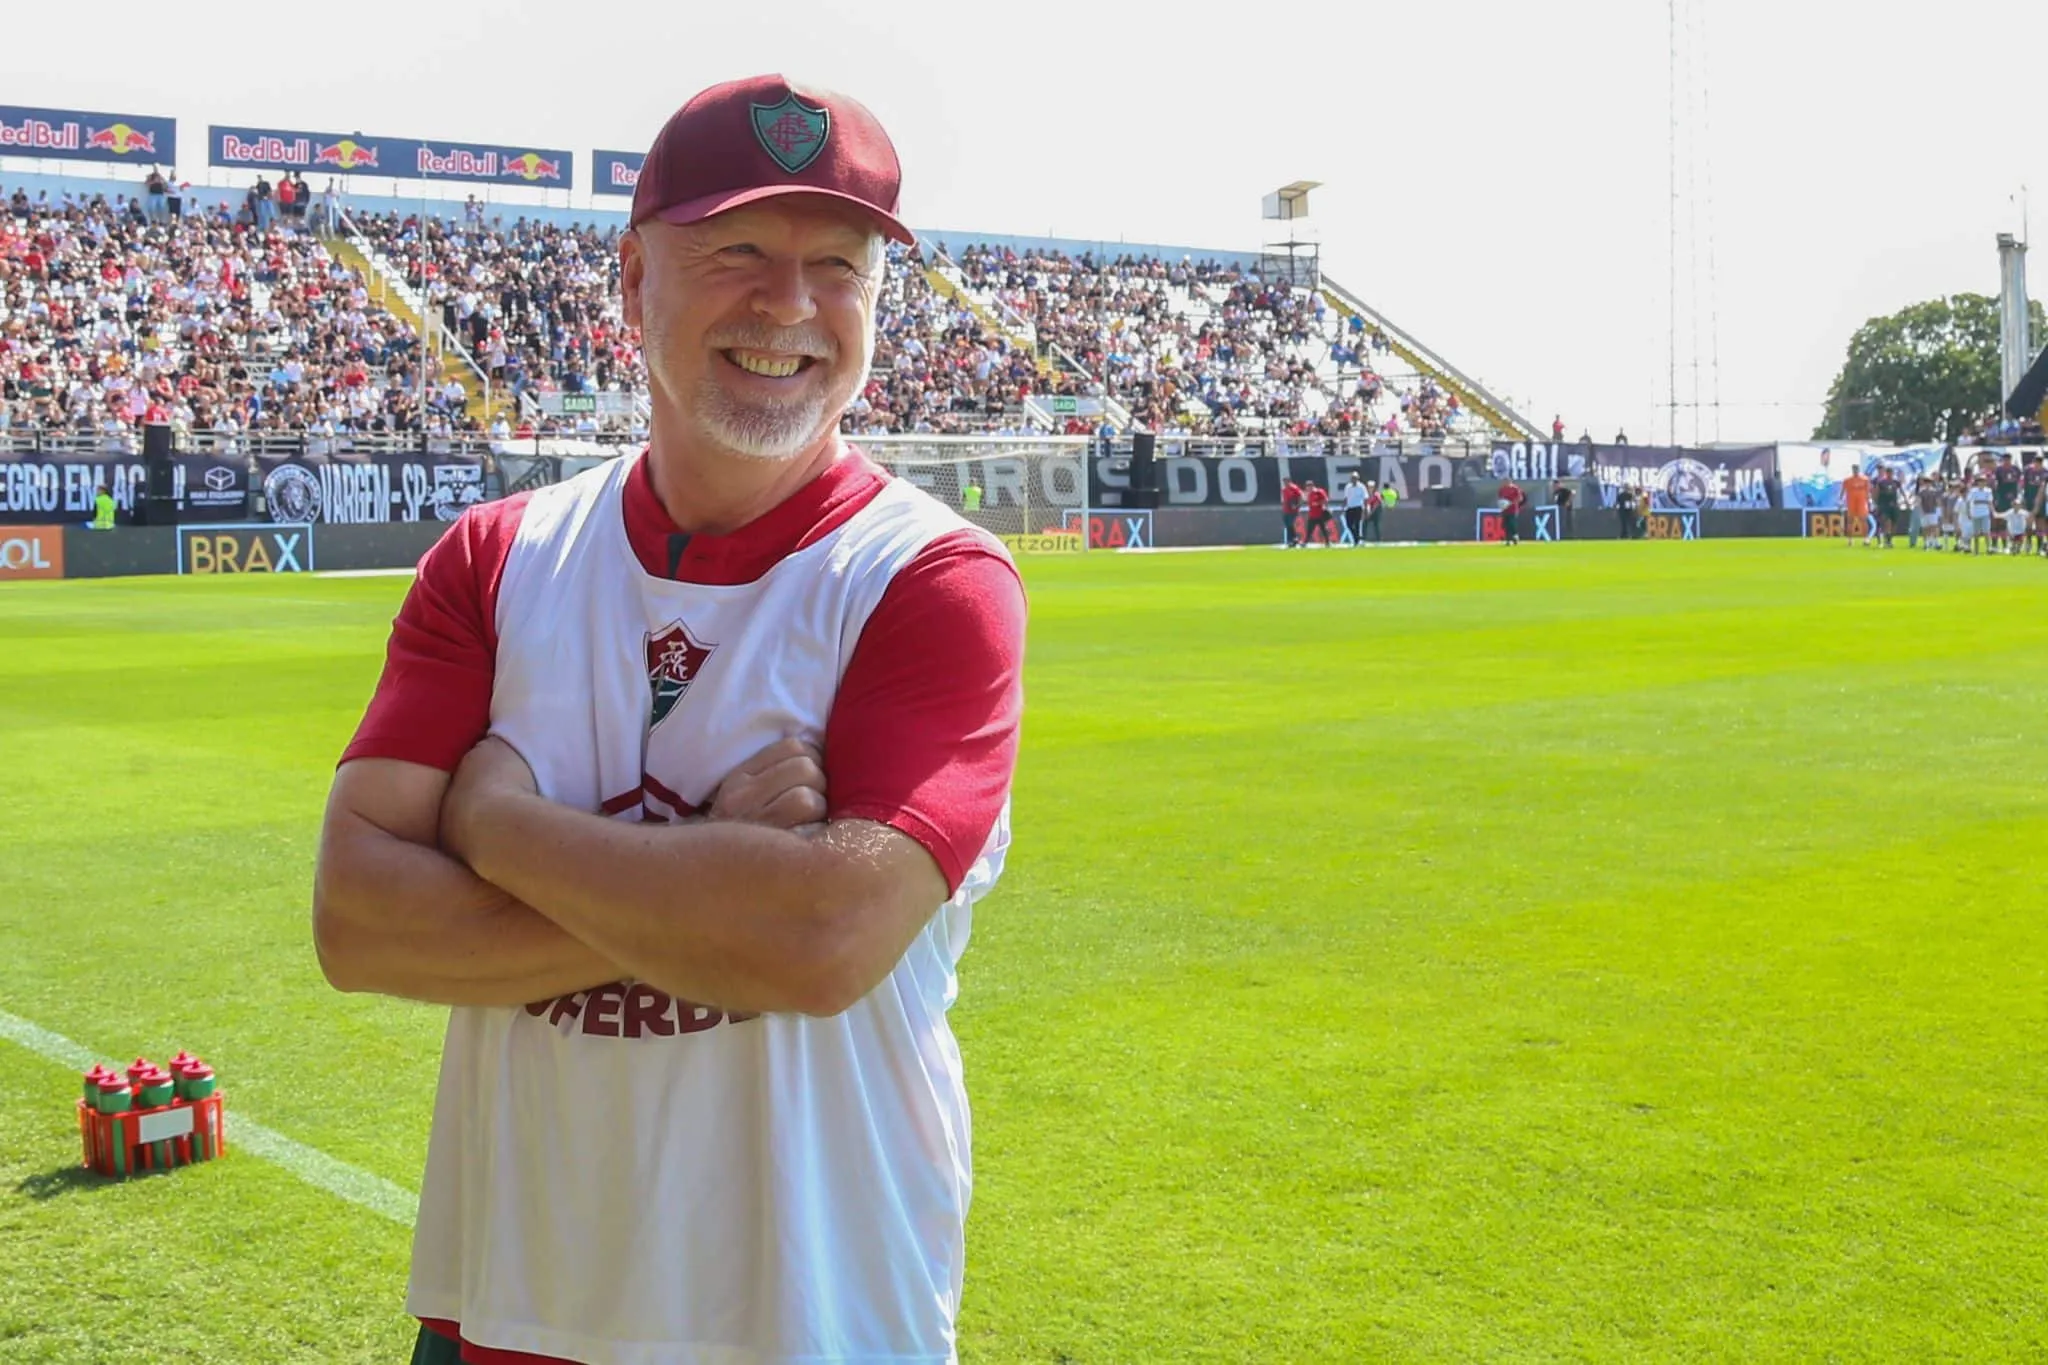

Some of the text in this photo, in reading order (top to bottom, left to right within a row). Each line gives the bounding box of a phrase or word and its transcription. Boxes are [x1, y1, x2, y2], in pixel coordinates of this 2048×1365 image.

[64, 463, 104, 511] EM
[1166, 457, 1258, 505] DO
[1646, 514, 1694, 541] BRAX
[190, 533, 301, 573] BRAX
